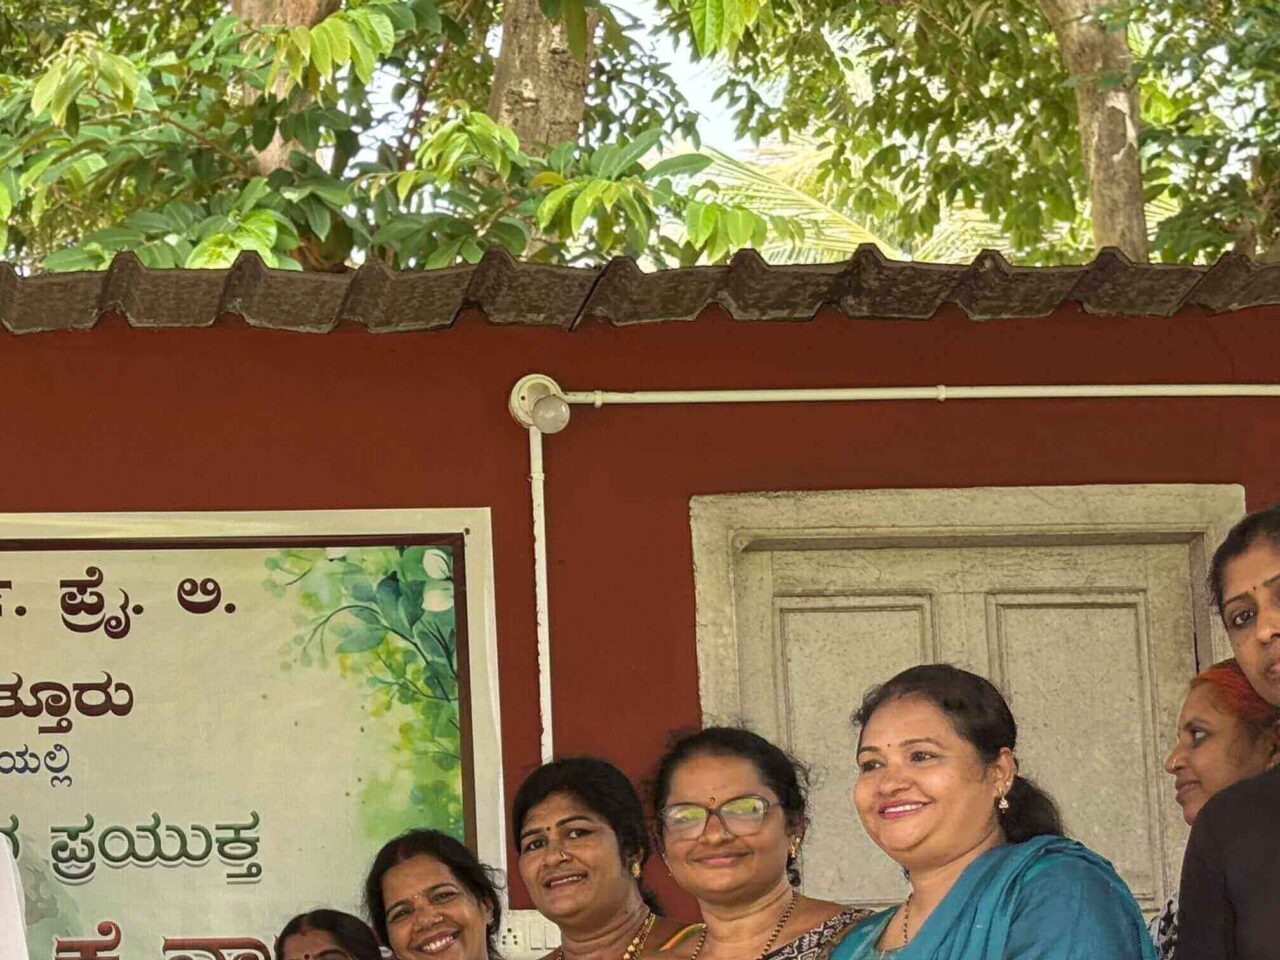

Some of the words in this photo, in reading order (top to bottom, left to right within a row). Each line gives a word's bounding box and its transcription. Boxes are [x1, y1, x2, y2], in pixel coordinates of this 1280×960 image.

[60, 566, 144, 639] ಪ್ರೈ.
[177, 578, 236, 614] ಲಿ.
[50, 810, 263, 881] ಪ್ರಯುಕ್ತ
